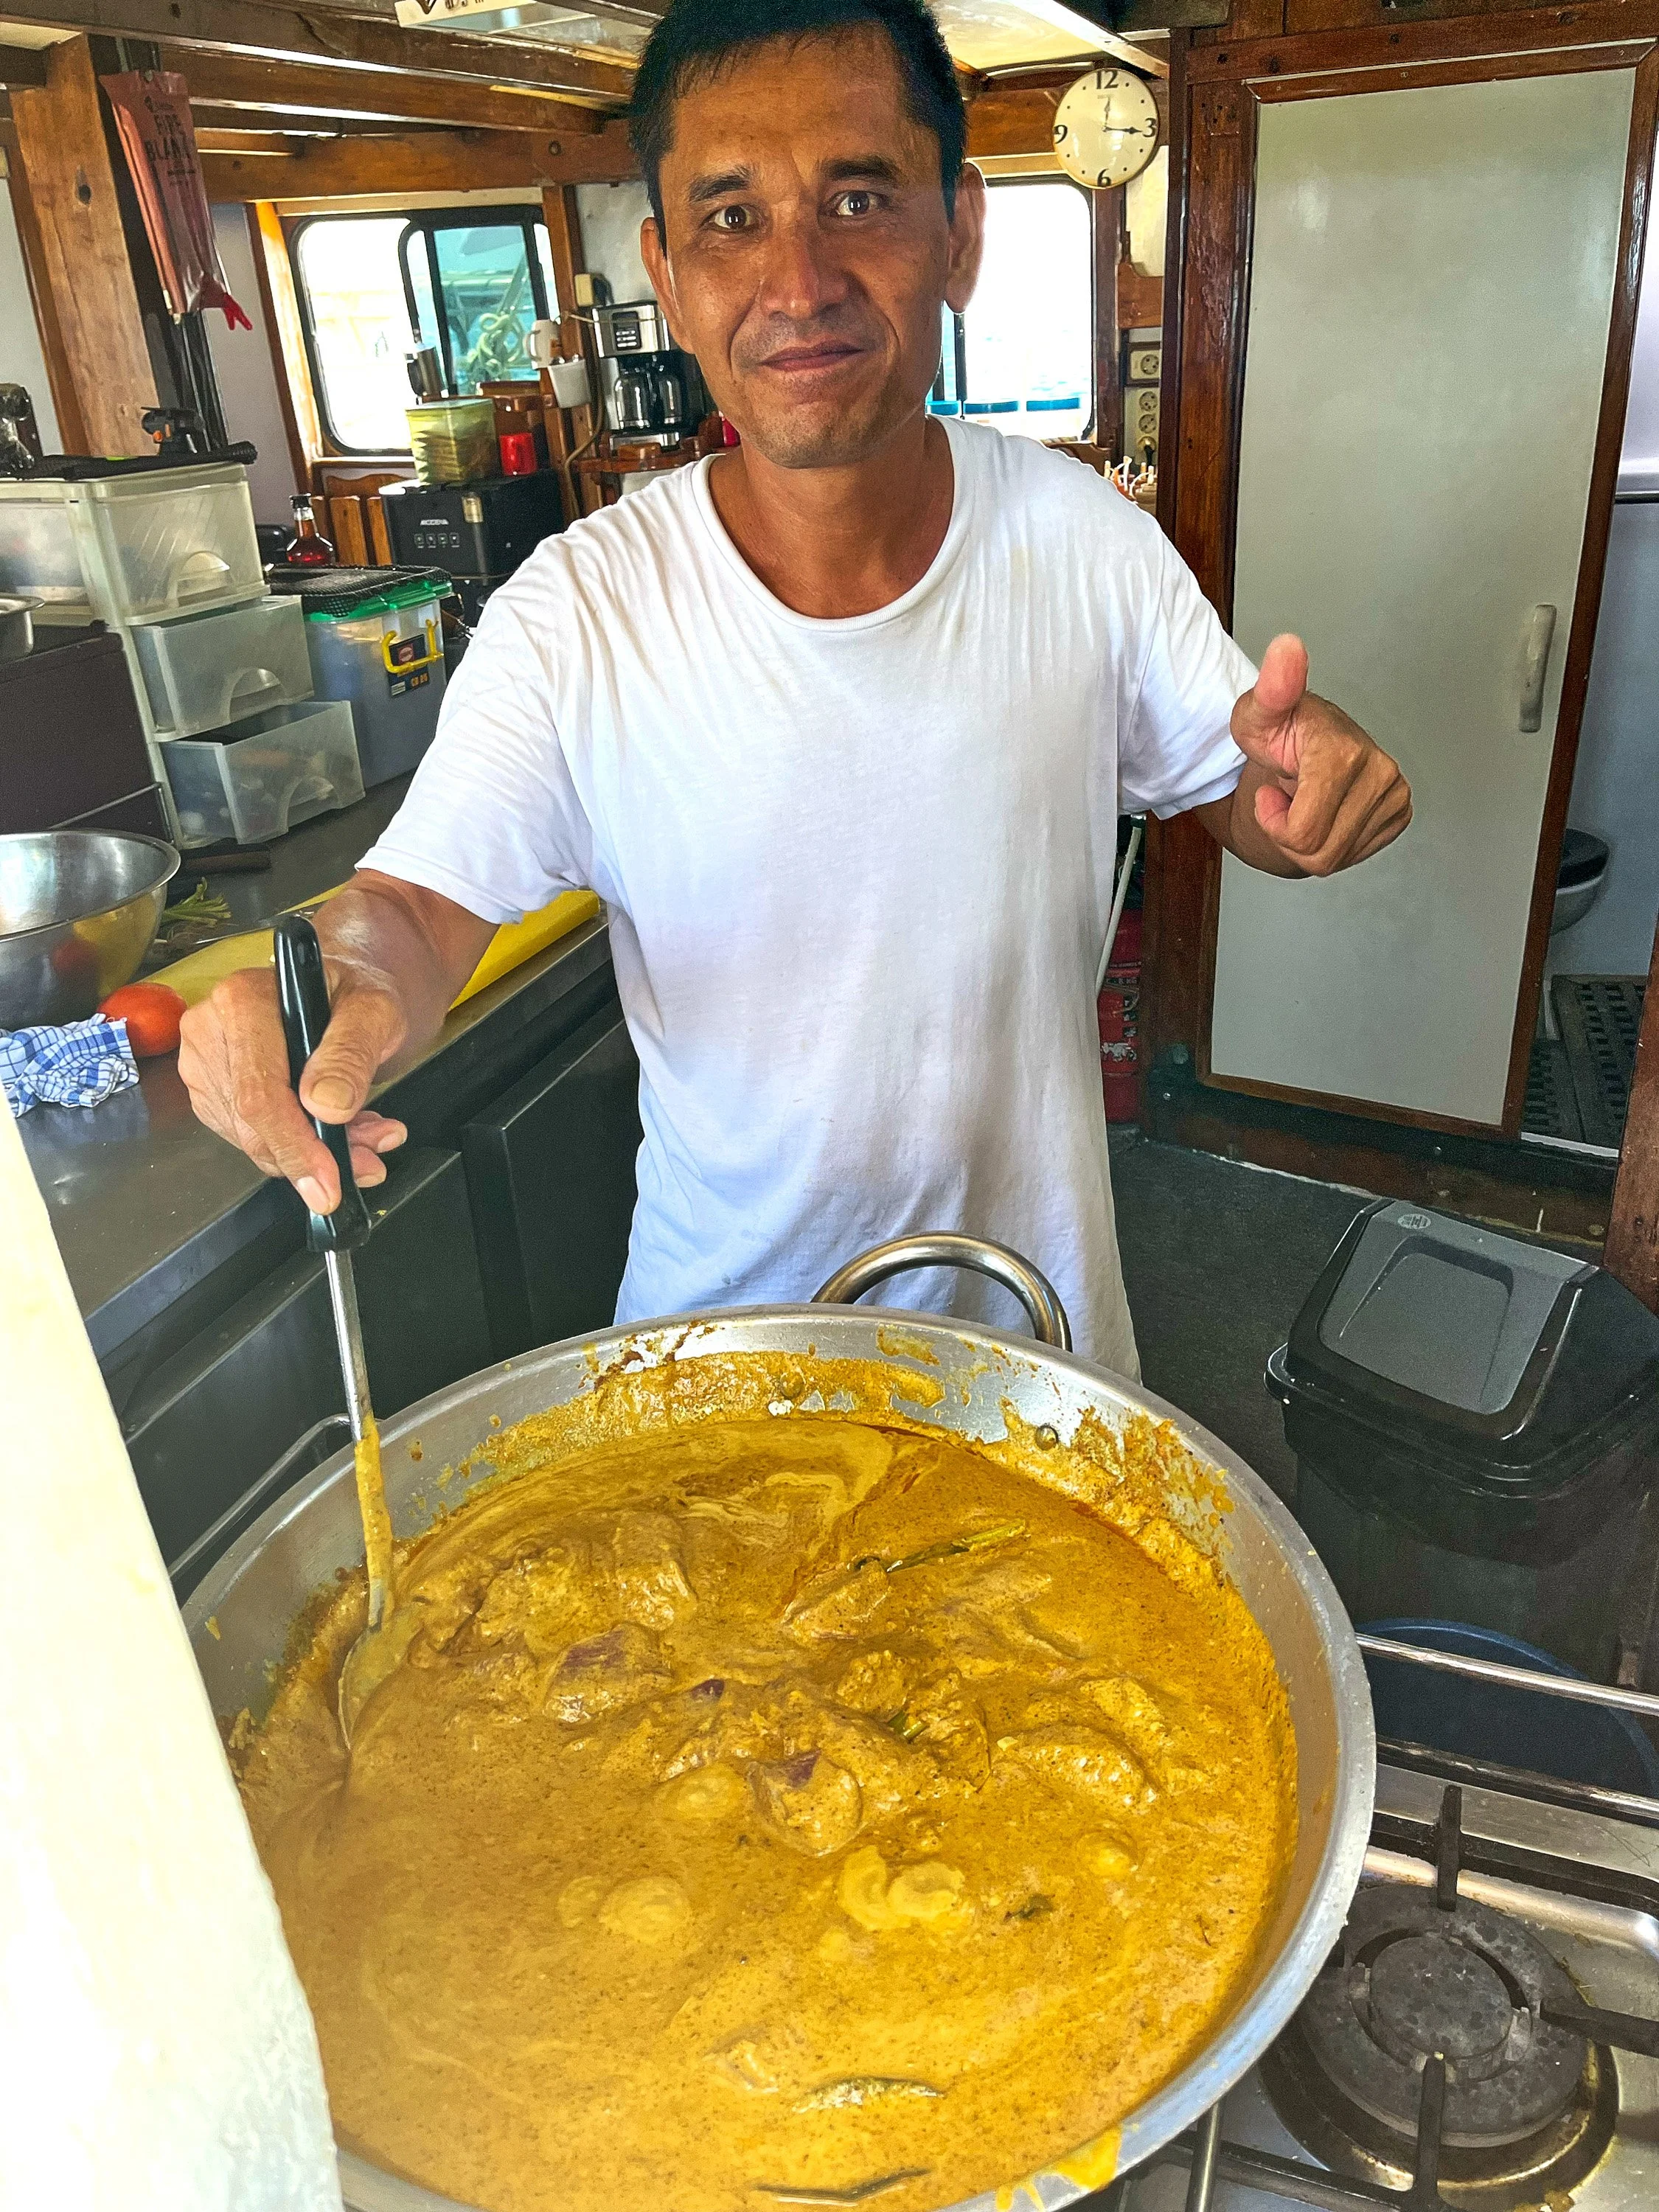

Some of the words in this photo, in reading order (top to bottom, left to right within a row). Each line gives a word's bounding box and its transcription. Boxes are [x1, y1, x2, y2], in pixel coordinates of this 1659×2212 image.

[1096, 70, 1119, 89] 12
[1054, 125, 1068, 144] 9
[1143, 117, 1157, 137] 3
[1097, 168, 1111, 187] 6
